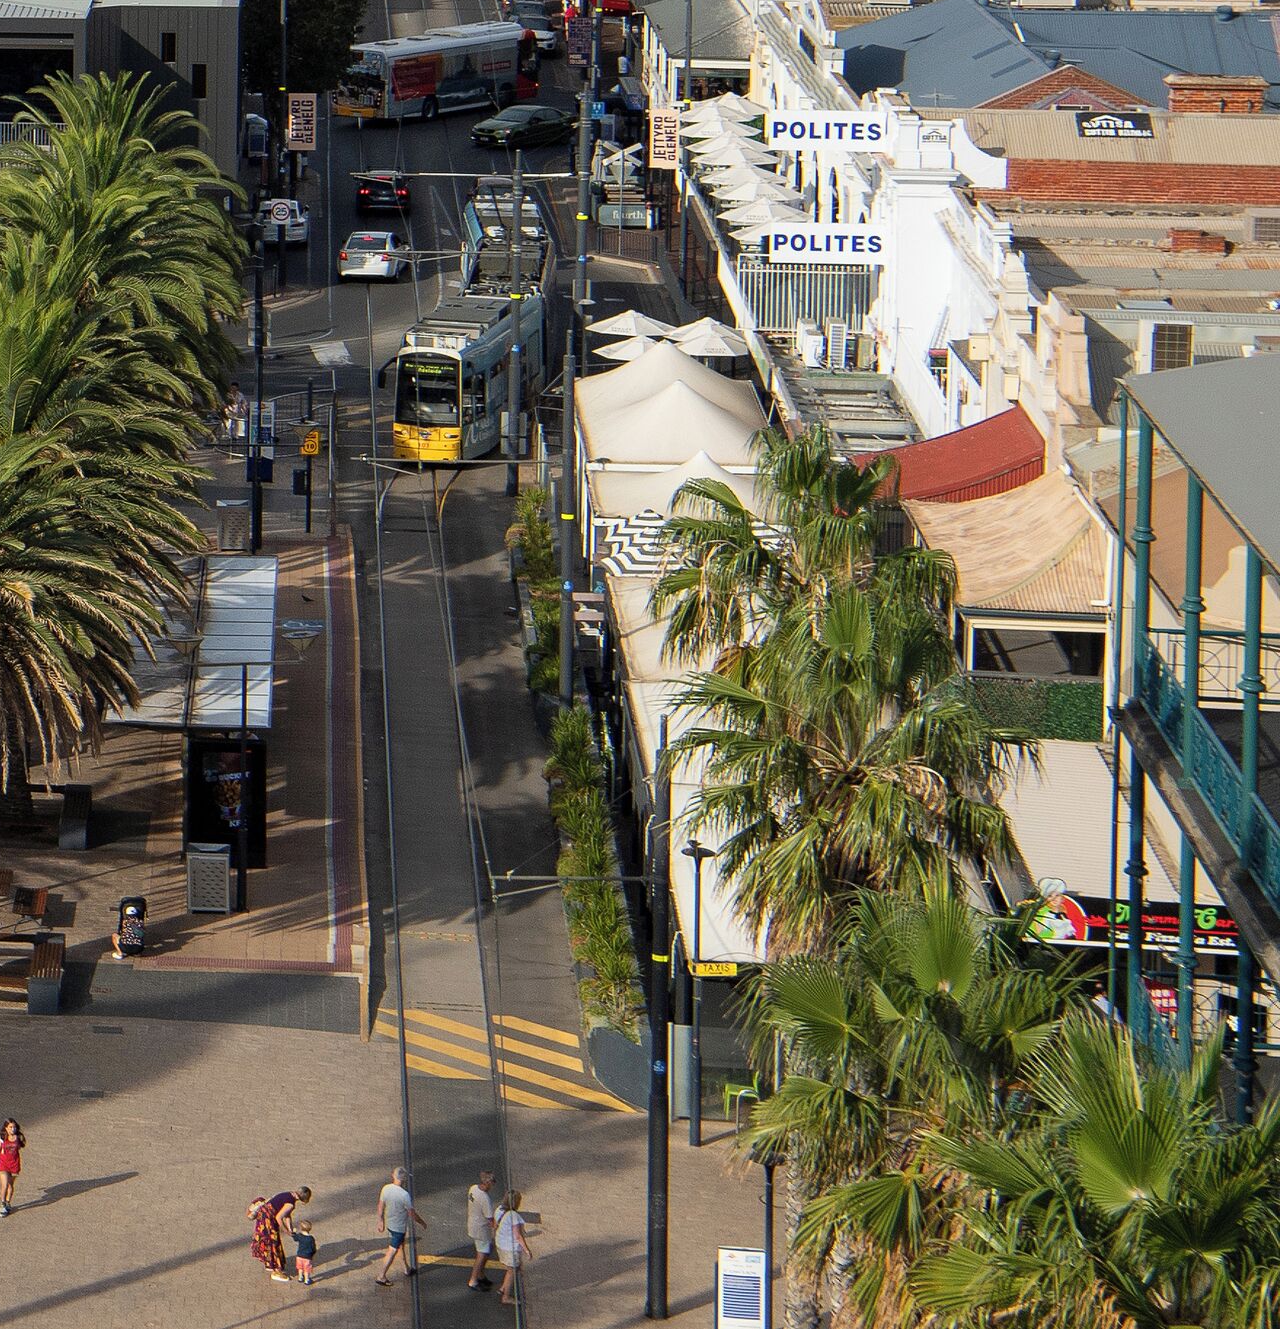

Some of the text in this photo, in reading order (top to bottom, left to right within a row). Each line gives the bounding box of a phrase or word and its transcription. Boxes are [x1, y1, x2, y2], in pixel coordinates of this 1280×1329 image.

[302, 99, 314, 144] GLENELG
[772, 121, 882, 141] POLITES
[653, 116, 667, 161] JETTYRD
[275, 206, 288, 217] 25
[773, 233, 883, 253] POLITES
[1207, 937, 1237, 947] Est.
[703, 964, 730, 973] TAXIS
